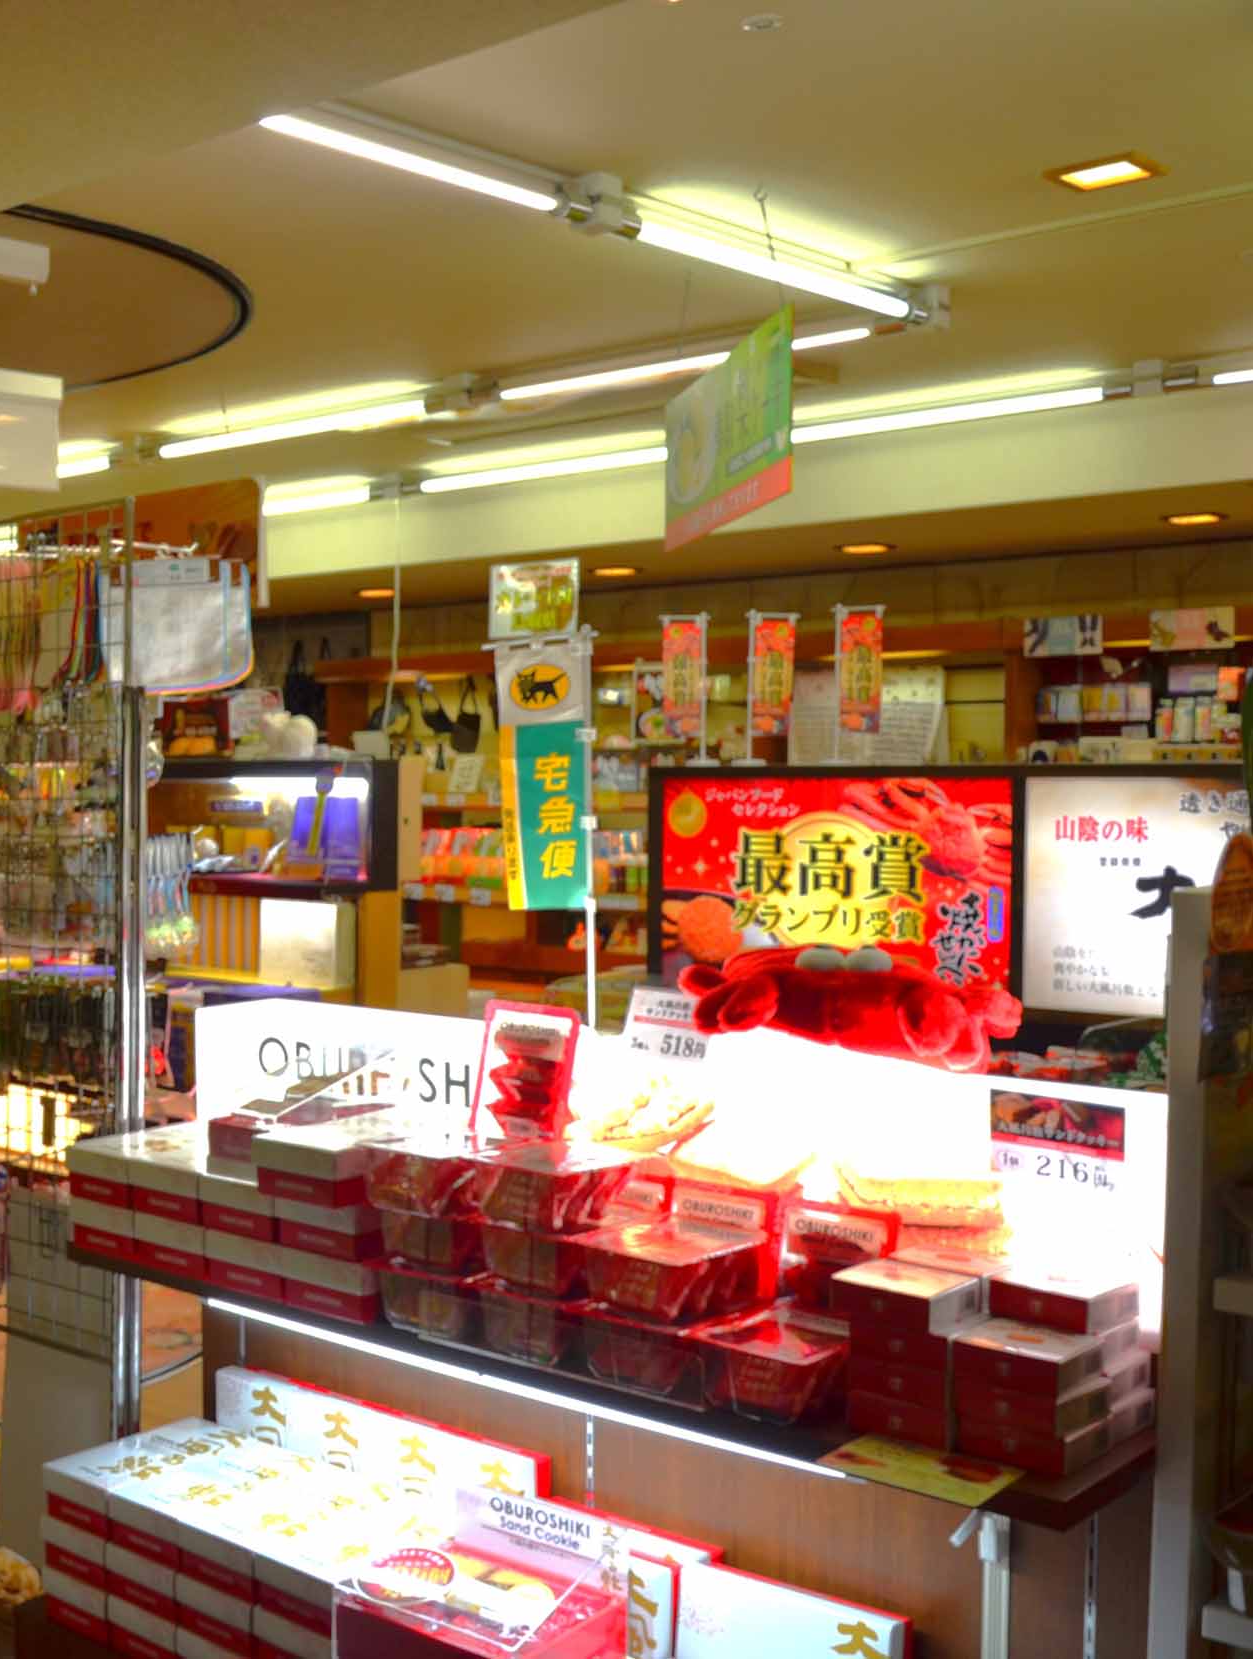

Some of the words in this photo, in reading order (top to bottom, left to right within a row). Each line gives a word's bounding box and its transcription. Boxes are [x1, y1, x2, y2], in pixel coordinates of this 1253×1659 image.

[534, 752, 578, 879] 宅急便
[1054, 815, 1149, 843] 山陰の味
[734, 831, 925, 903] 最高賞
[733, 903, 925, 942] グランプリ受賞
[490, 1496, 591, 1539] OBUROSHIKI
[499, 1516, 531, 1535] Sand
[534, 1526, 580, 1550] Cookie
